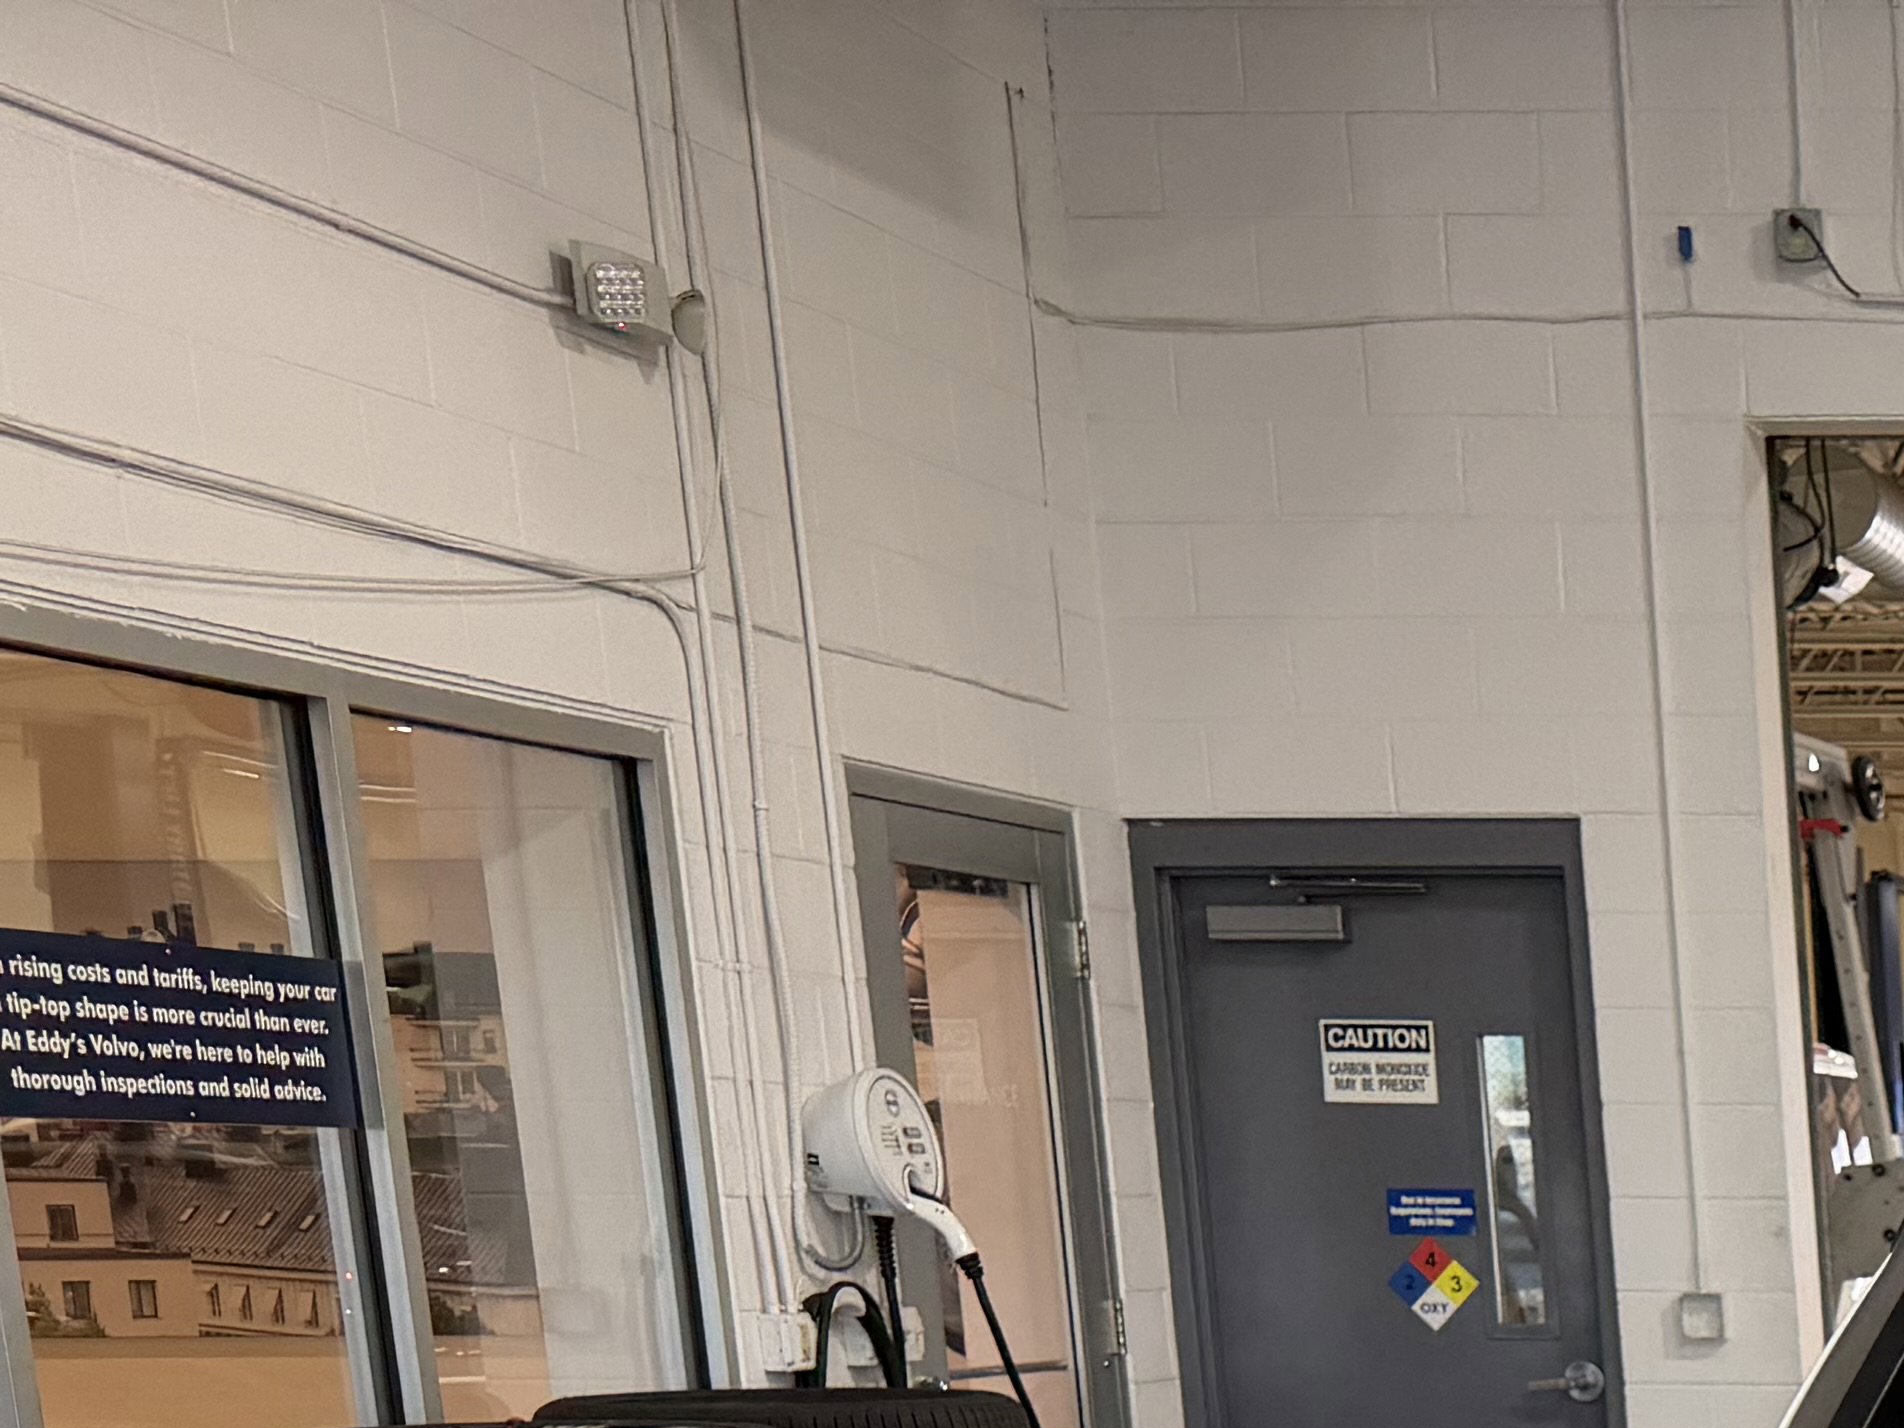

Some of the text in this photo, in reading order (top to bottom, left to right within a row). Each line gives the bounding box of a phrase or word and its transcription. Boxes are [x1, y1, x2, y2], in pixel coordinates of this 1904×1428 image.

[9, 955, 336, 1003] rising costs and tariffs, keeping your car
[6, 992, 329, 1035] tip-top shape is more crucial than ever.
[1327, 1027, 1428, 1051] CAUTION
[1, 1029, 326, 1071] At Eddy's Volvo, we're here to help with
[1329, 1062, 1430, 1077] CARBON MONOXIDE
[11, 1067, 327, 1102] thorough inspections and solid advice.
[1334, 1078, 1425, 1092] MAY BE PRESENT
[1425, 1251, 1438, 1269] 4
[1403, 1274, 1416, 1290] 2
[1450, 1275, 1463, 1294] 3
[1420, 1302, 1449, 1316] OXY
